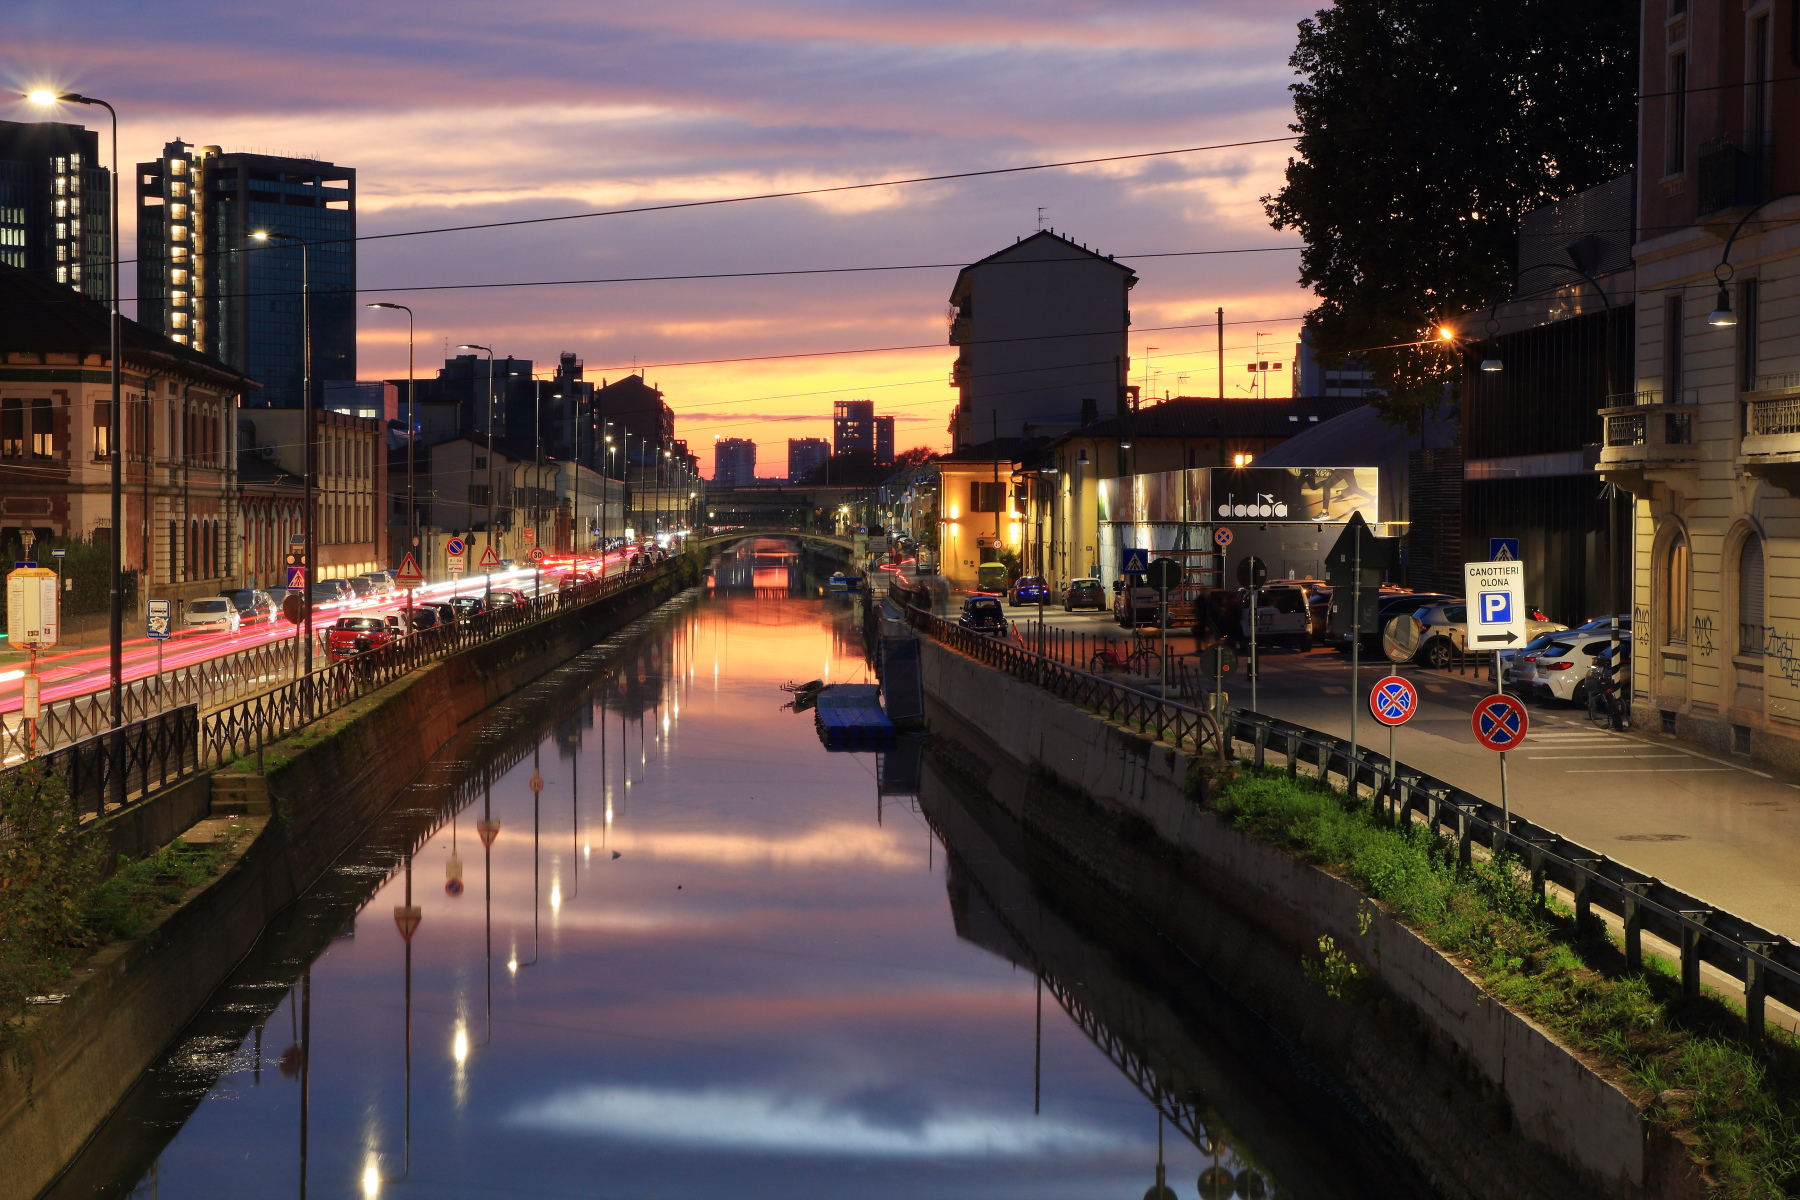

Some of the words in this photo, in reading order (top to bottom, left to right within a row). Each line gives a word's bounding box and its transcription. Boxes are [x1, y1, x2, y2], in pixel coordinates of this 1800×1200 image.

[1218, 493, 1288, 517] diadora
[533, 551, 542, 559] 30
[1469, 566, 1519, 577] CANOTTIERI
[1480, 578, 1510, 587] OLONA
[1485, 595, 1507, 622] P
